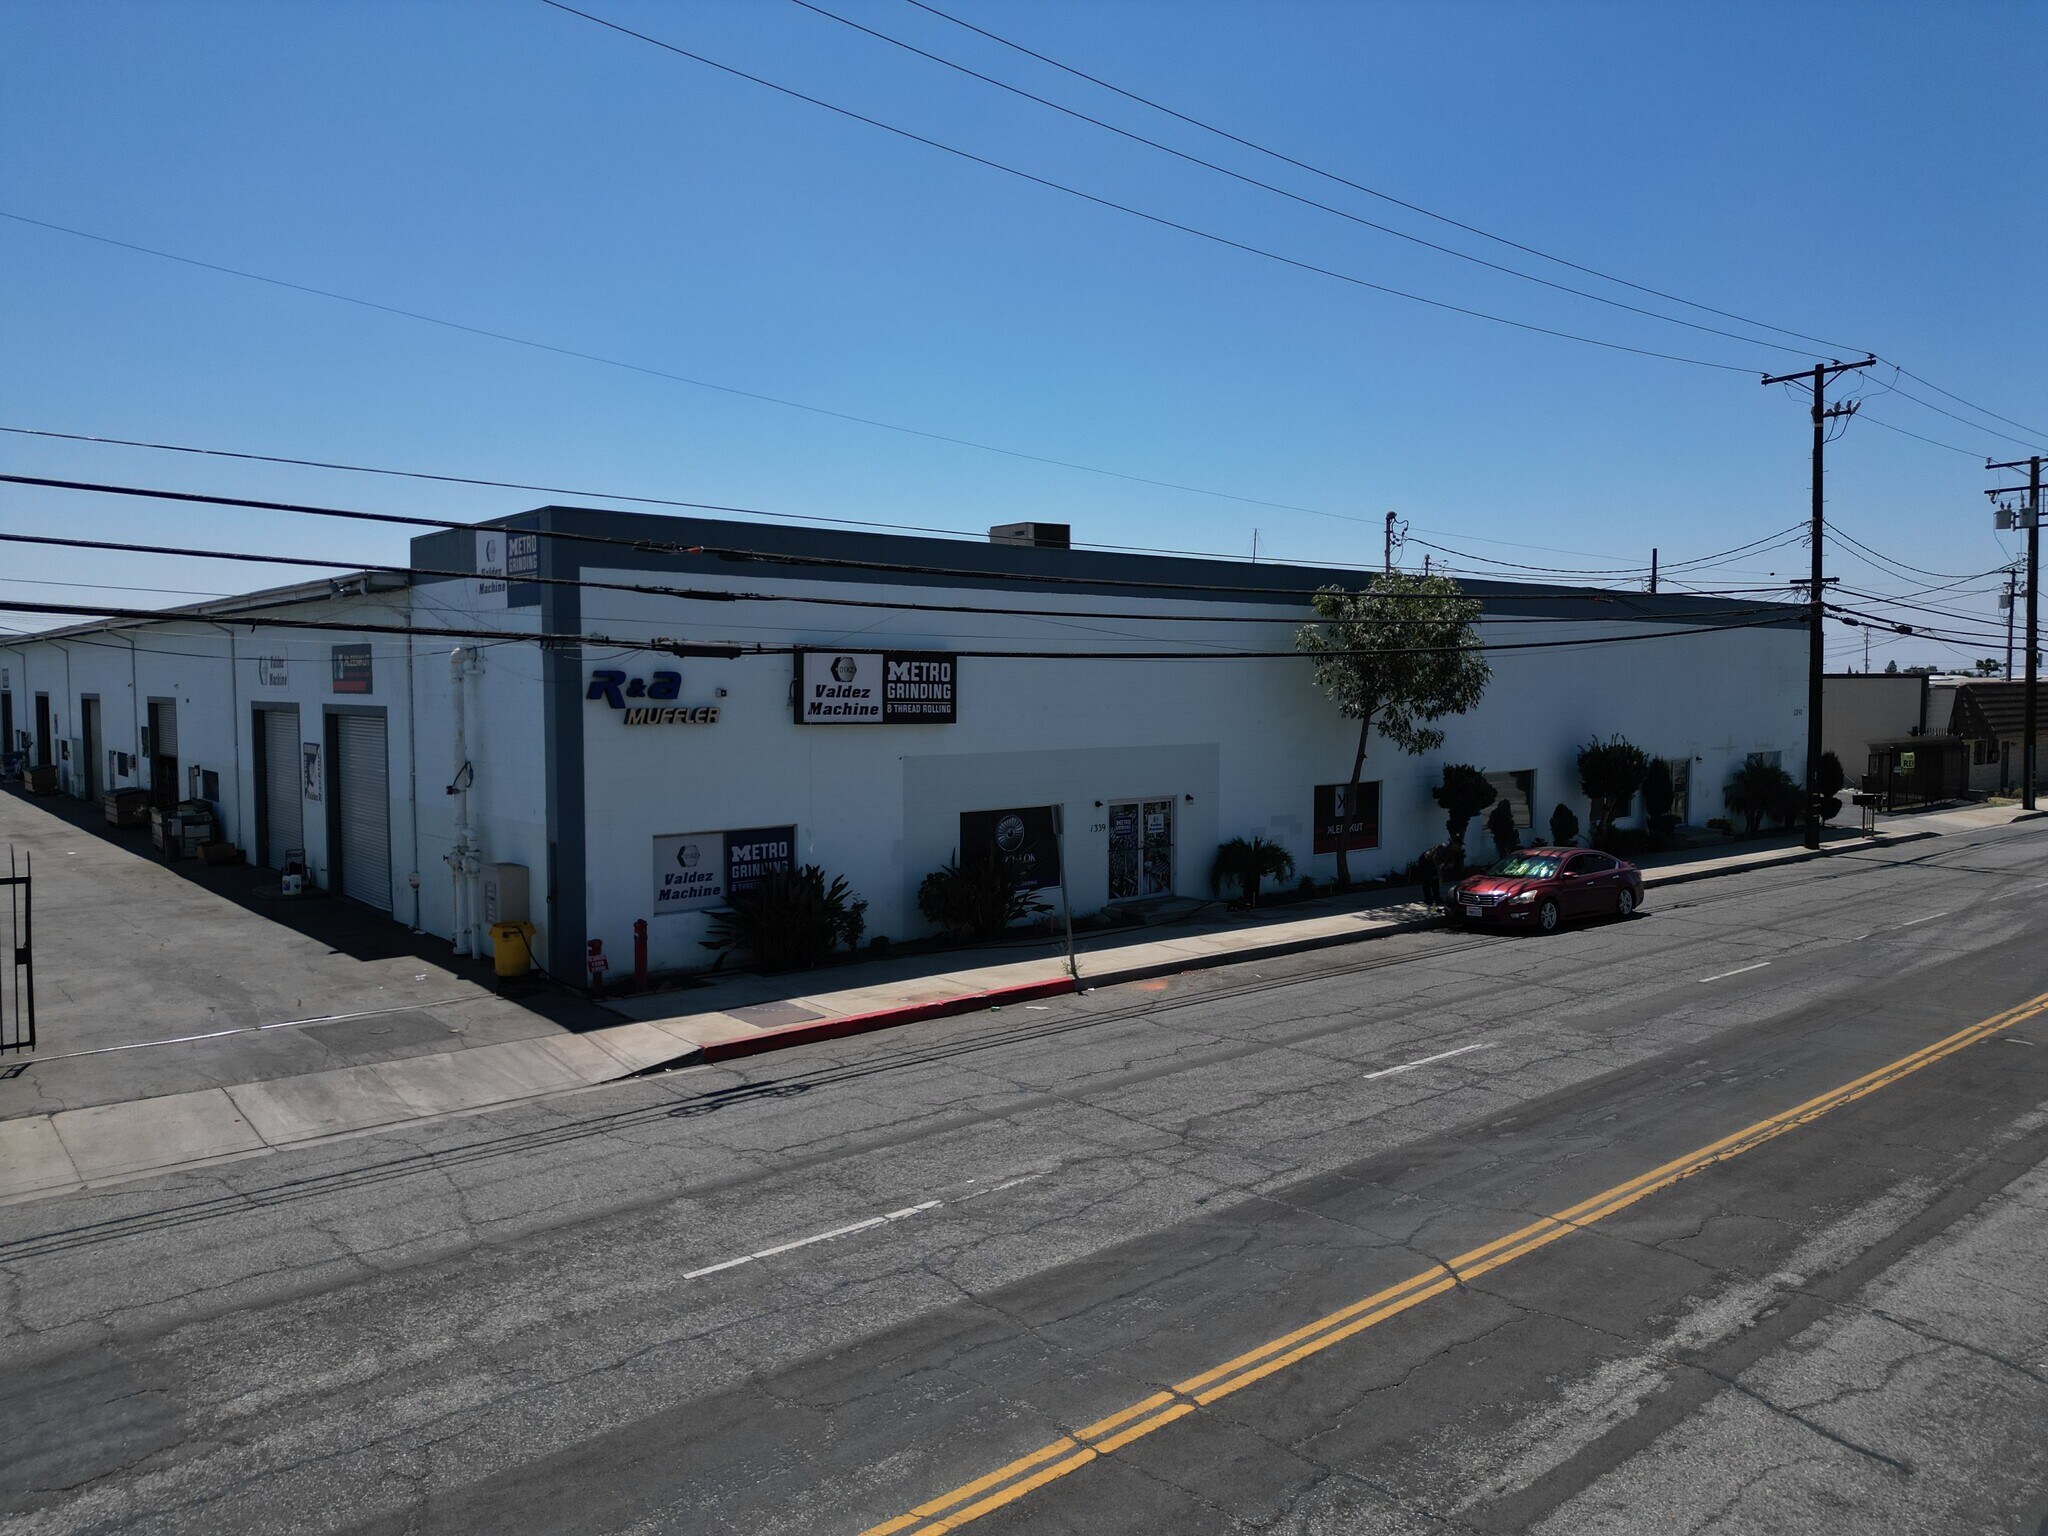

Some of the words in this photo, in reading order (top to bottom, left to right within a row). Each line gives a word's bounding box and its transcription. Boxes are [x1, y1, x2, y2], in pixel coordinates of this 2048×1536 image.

[508, 534, 537, 557] METRO
[508, 554, 538, 572] GRINDING
[479, 582, 506, 595] Machine
[887, 661, 951, 682] METRO
[815, 684, 871, 699] Valdez
[887, 683, 951, 700] GRINDING
[623, 707, 720, 725] MUFFLER
[807, 702, 879, 716] Machine
[887, 704, 892, 713] &
[893, 704, 921, 713] THREAD
[923, 704, 952, 713] ROLLING
[1090, 823, 1107, 832] 1339
[731, 841, 788, 863] METRO
[665, 871, 714, 886] Valdez
[658, 886, 721, 902] Machine
